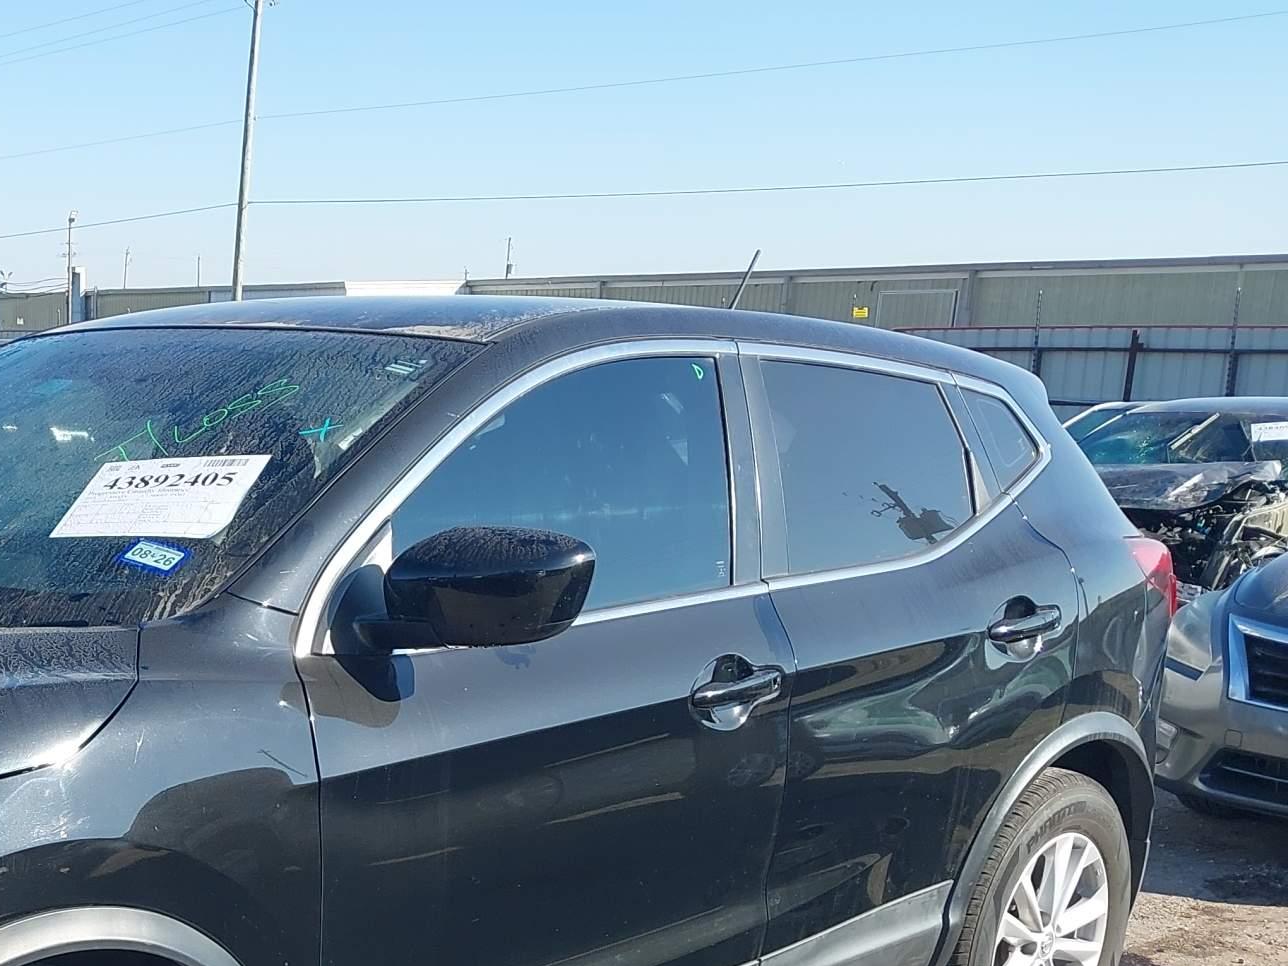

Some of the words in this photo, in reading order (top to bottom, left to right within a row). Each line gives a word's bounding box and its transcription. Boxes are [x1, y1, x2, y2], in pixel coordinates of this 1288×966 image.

[104, 470, 238, 491] 43892405
[131, 547, 152, 560] 08
[153, 553, 176, 567] 26
